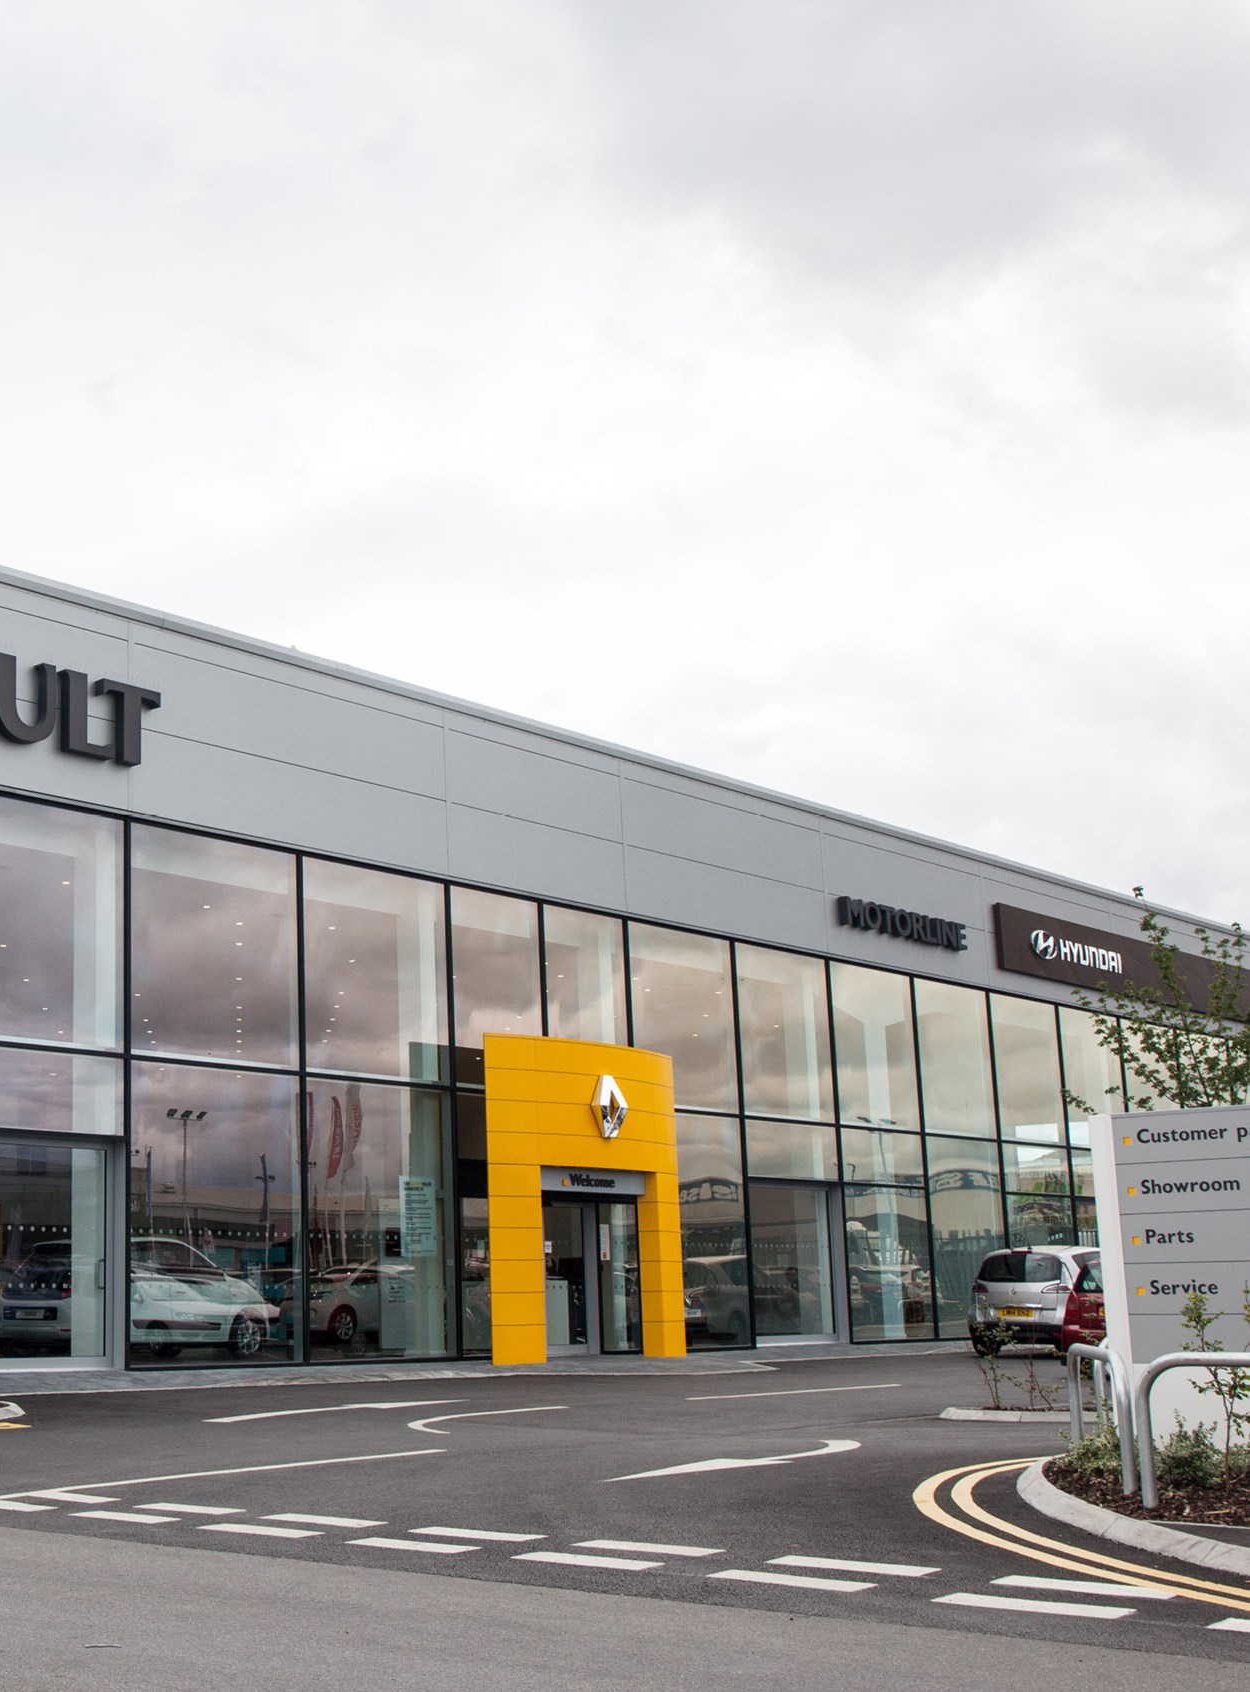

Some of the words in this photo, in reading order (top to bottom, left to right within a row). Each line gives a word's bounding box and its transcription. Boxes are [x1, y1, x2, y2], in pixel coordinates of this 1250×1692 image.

[838, 896, 967, 951] MOTORLINE
[1058, 938, 1122, 974] HYUNDAI
[1136, 1128, 1227, 1144] Customer
[1236, 1126, 1250, 1142] p
[568, 1173, 616, 1189] Welcome
[1140, 1179, 1240, 1194] Showroom
[1144, 1229, 1194, 1244] Parts
[1150, 1279, 1219, 1295] Service
